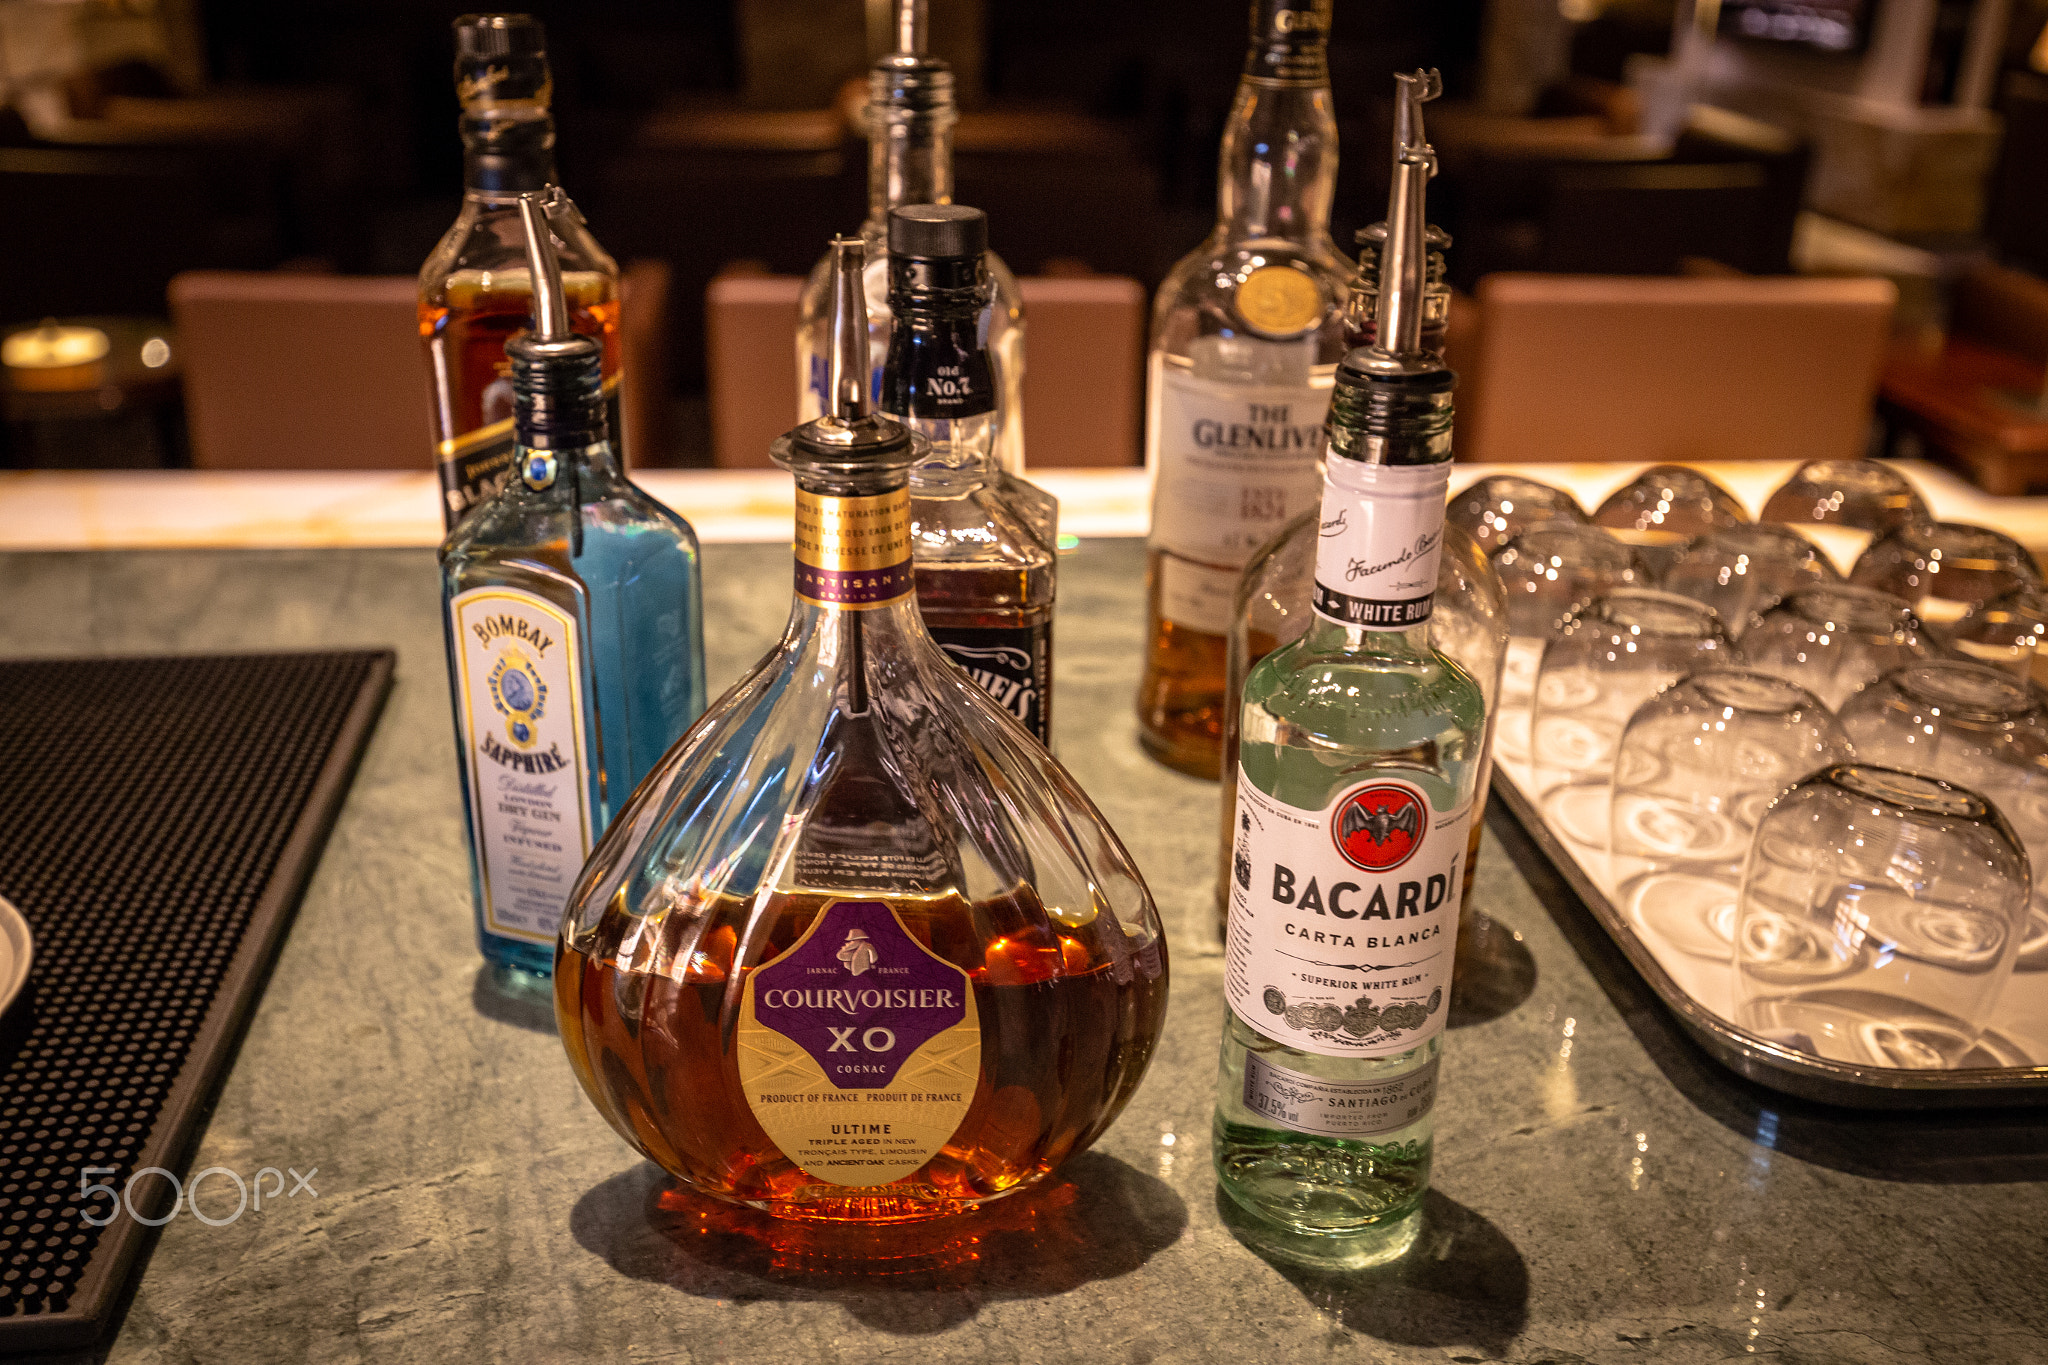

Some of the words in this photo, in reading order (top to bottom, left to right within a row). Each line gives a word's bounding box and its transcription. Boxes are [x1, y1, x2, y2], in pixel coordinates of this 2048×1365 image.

[806, 573, 892, 588] ARTISAN
[1348, 600, 1403, 622] WHITE
[472, 614, 555, 658] BOMBAY
[480, 731, 567, 774] SAPPHIRE
[1272, 853, 1459, 921] BACARDÍ
[1284, 923, 1355, 948] CARTA
[1367, 924, 1440, 948] BLANCA
[806, 967, 838, 975] JARNAC
[1300, 973, 1358, 990] SUPERIOR
[1362, 979, 1398, 990] WHITE
[1402, 974, 1422, 987] RUM
[764, 989, 957, 1015] COURVOISIER
[827, 1027, 897, 1053] XO
[836, 1065, 887, 1074] COGNAC
[760, 1094, 805, 1103] PRODUCT
[807, 1094, 820, 1102] OF
[822, 1093, 858, 1102] FRANCE
[867, 1093, 908, 1102] PRODUIT
[910, 1094, 924, 1102] DE
[926, 1093, 962, 1102] FRANCE
[1258, 1092, 1287, 1118] 37.5%
[1328, 1094, 1398, 1108] SANTIAGO
[831, 1124, 892, 1134] ULTIME
